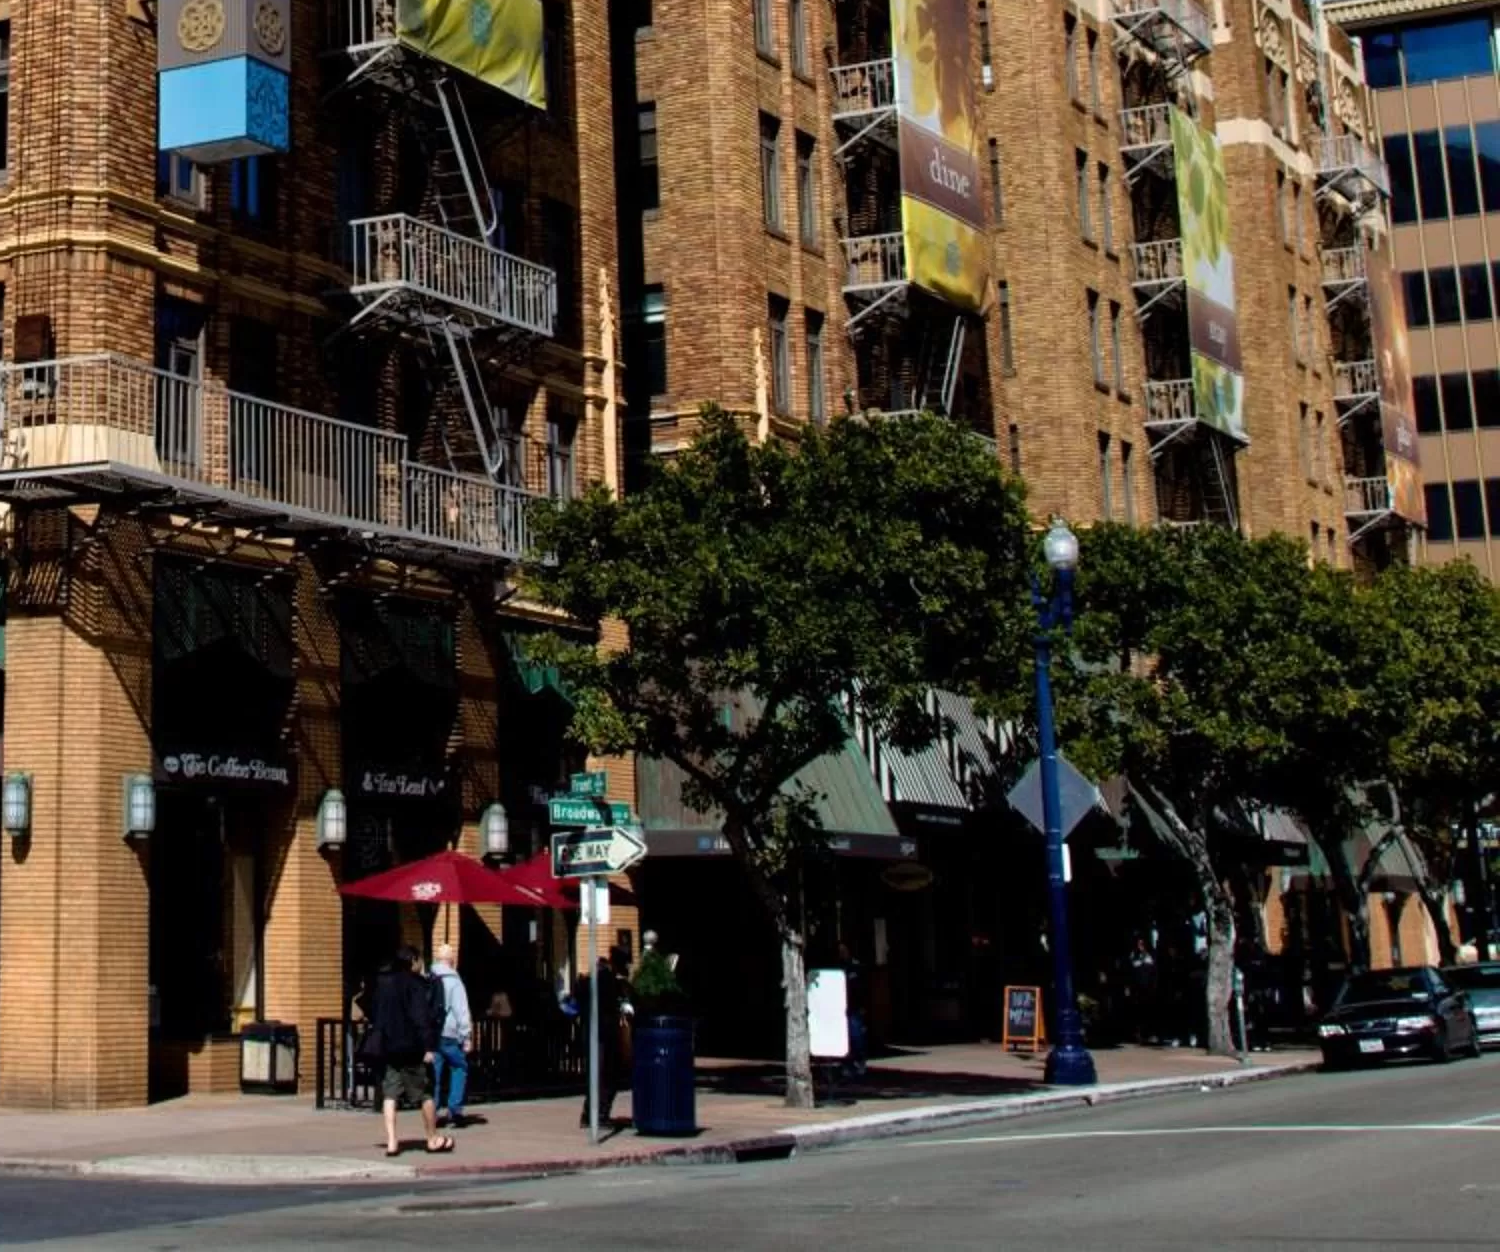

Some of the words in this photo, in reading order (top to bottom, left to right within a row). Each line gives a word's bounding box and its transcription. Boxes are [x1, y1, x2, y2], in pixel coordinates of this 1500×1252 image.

[928, 146, 971, 199] dine
[179, 752, 207, 779] The
[207, 753, 250, 780] Coffee
[553, 803, 604, 822] Broadwa
[585, 843, 612, 858] WAY
